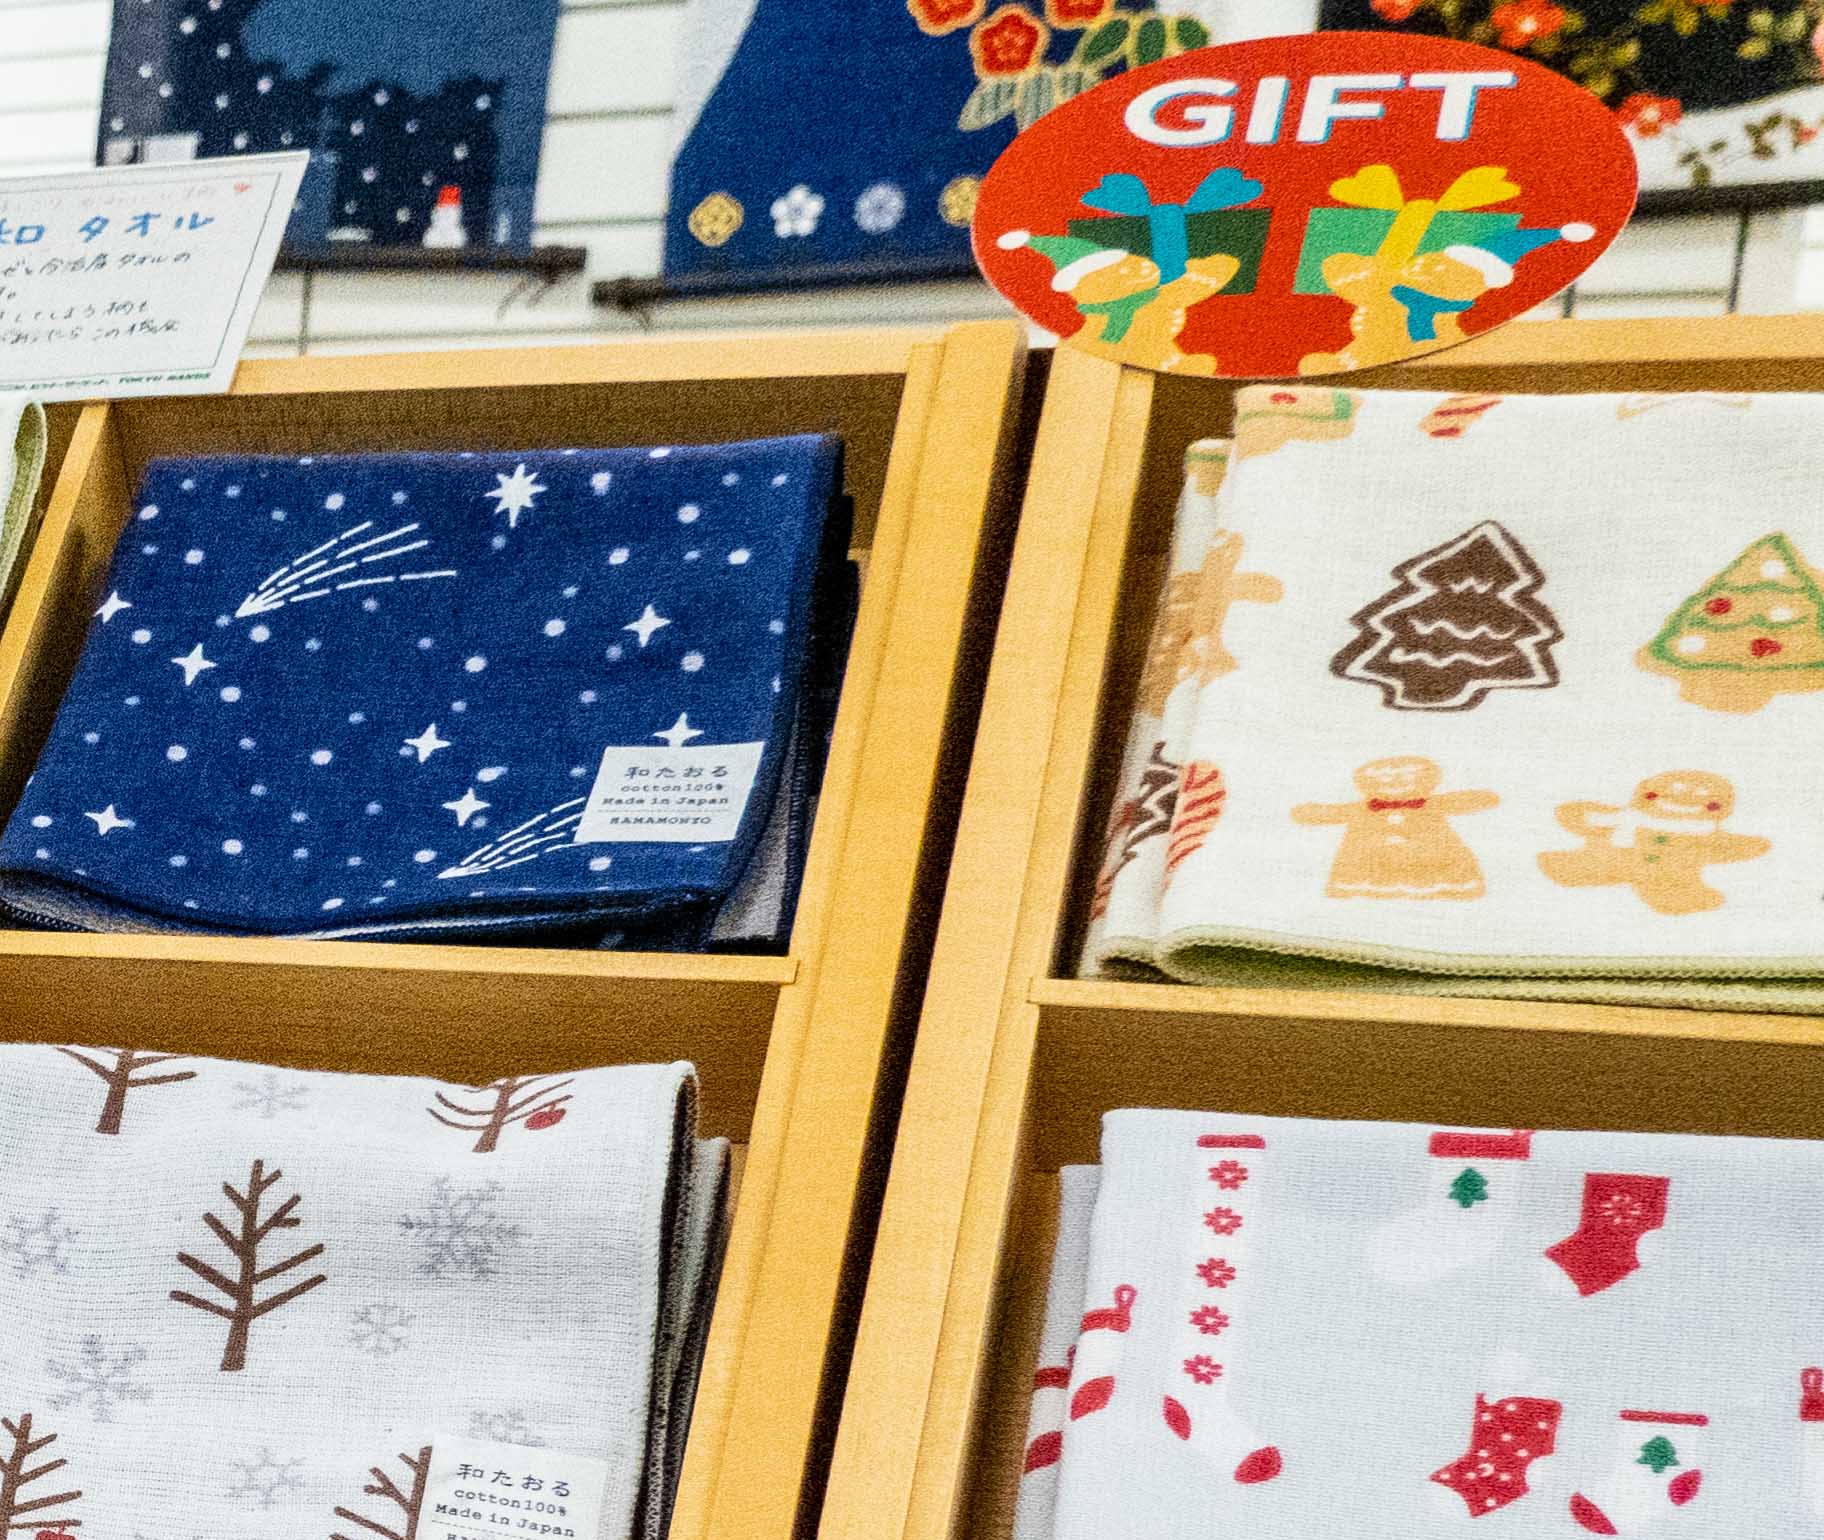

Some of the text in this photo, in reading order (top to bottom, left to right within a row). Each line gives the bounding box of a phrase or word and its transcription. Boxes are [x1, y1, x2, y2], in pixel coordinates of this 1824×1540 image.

[1125, 71, 1517, 147] GIFT
[457, 1463, 570, 1497] 和たおる
[454, 1488, 566, 1516] cotton100%
[435, 1504, 574, 1537] Made in Japan
